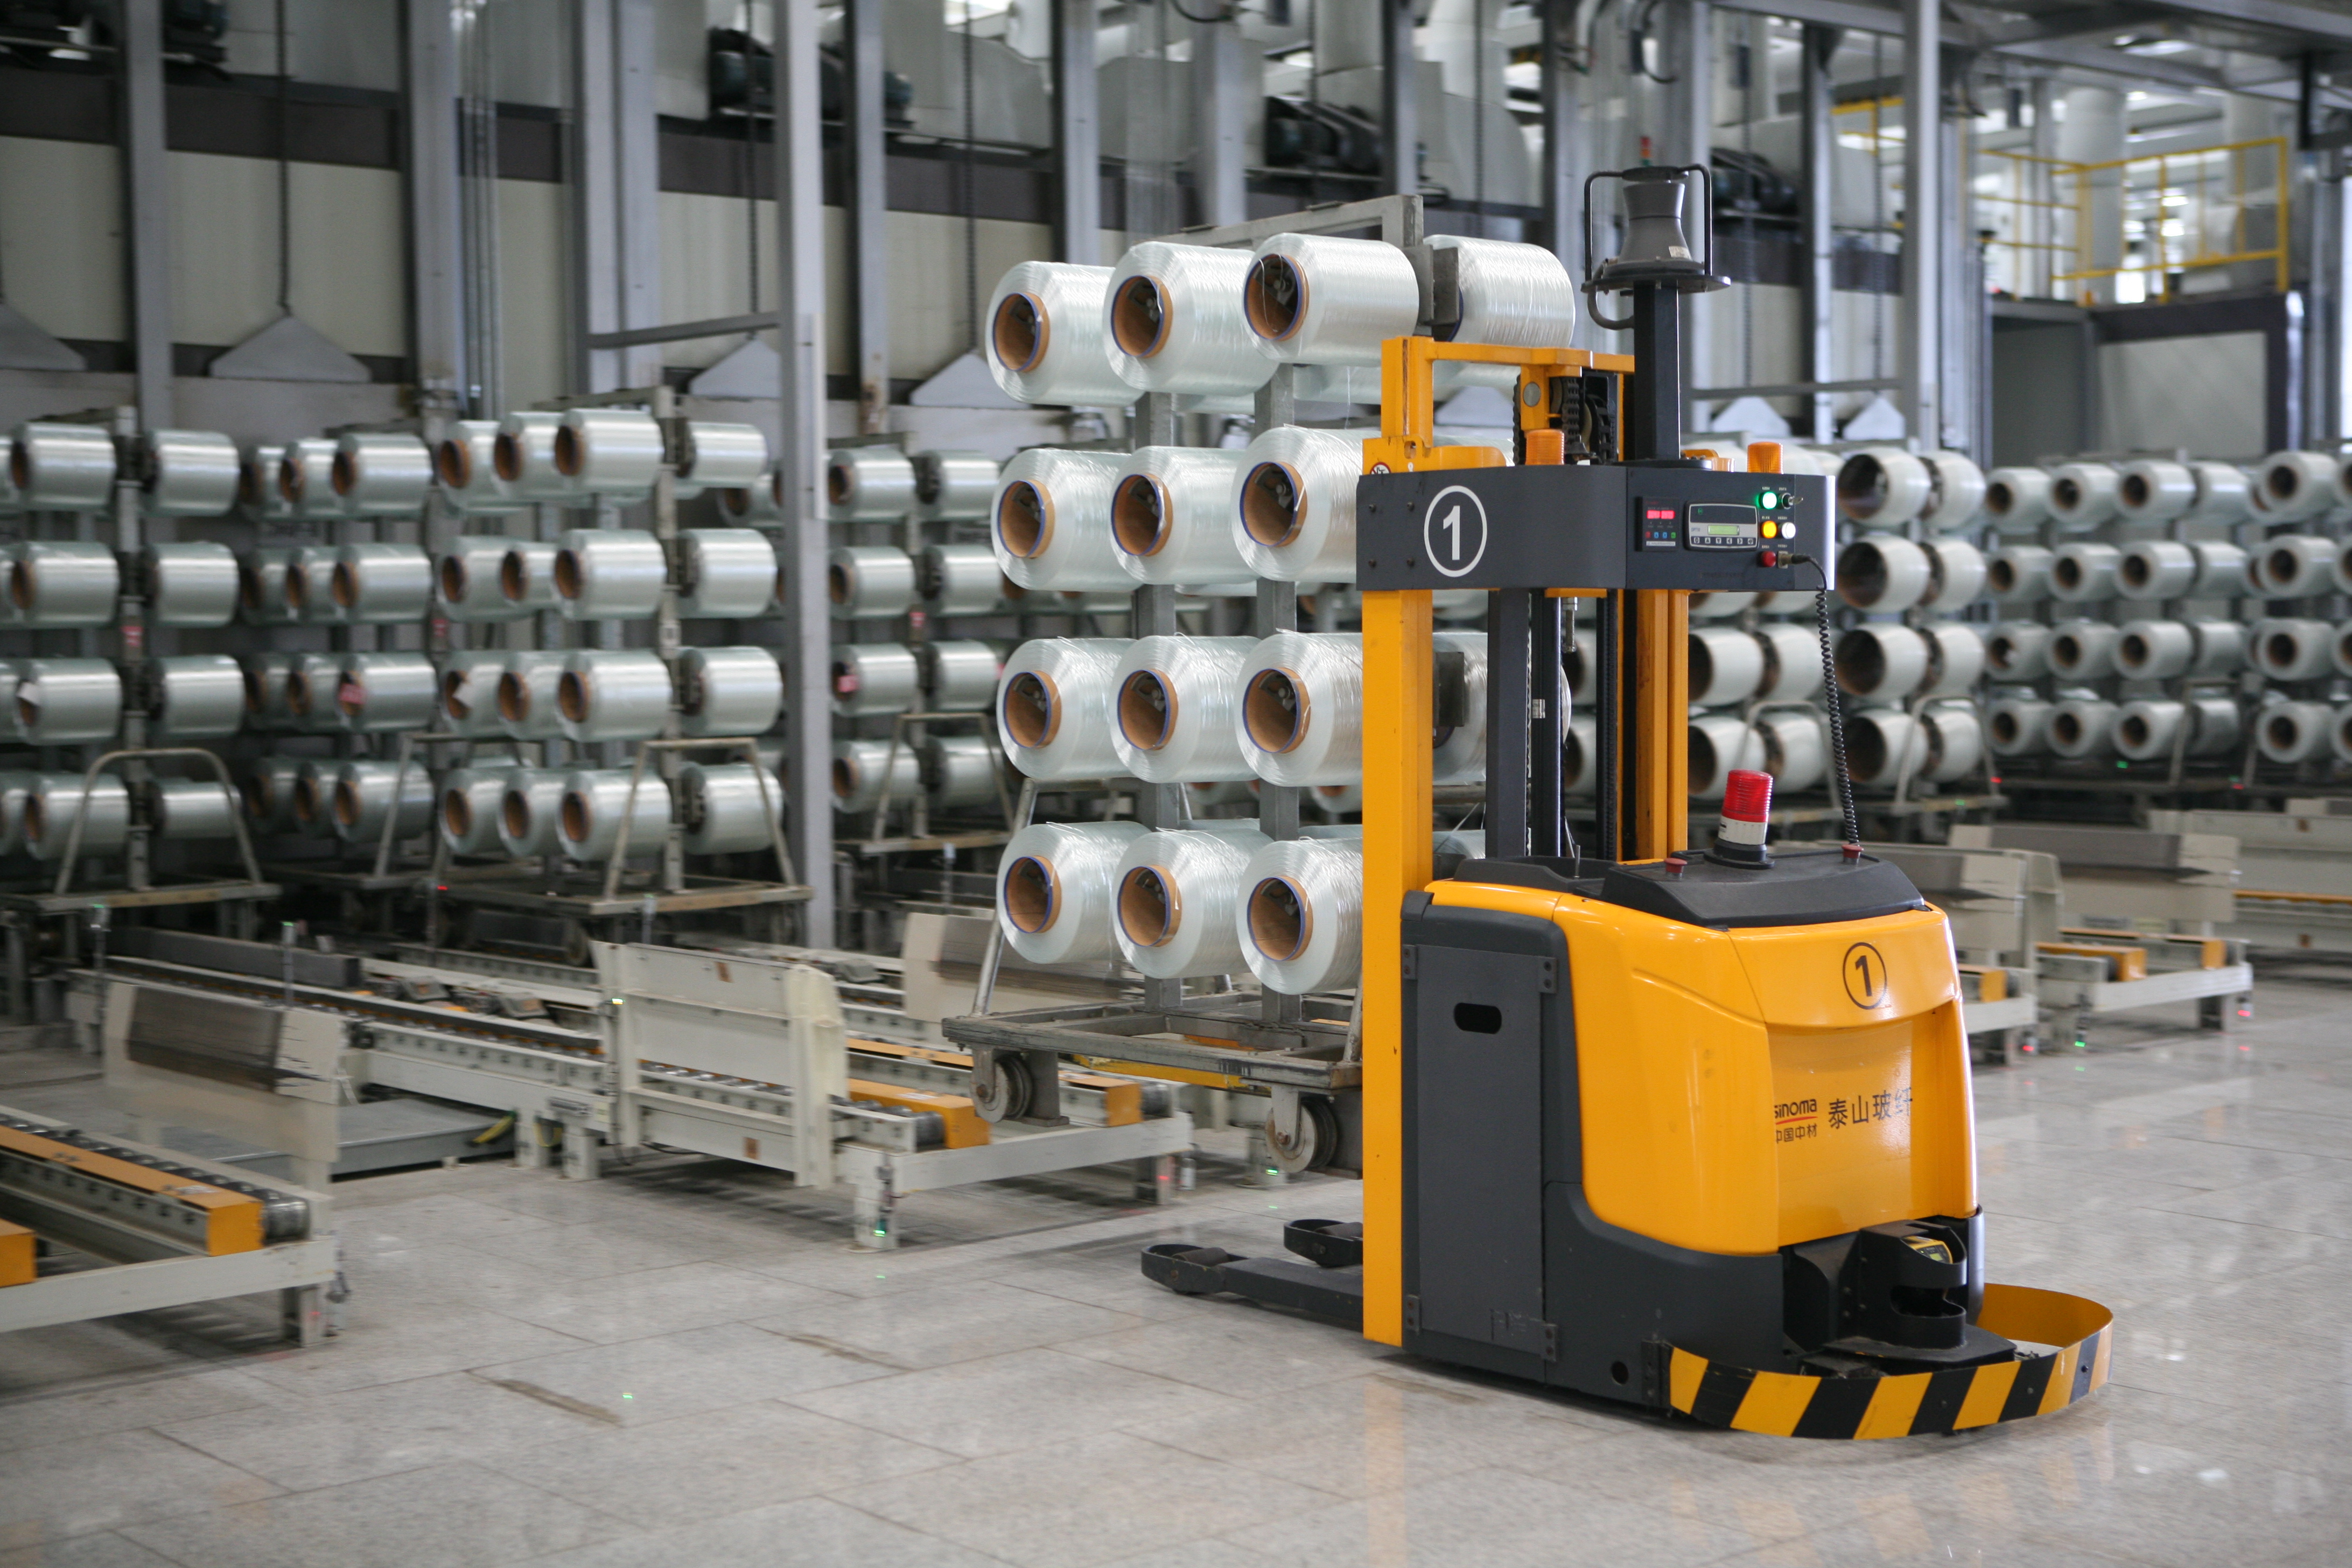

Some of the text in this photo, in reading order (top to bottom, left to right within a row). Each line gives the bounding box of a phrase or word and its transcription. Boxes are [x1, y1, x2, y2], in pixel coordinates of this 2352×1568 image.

[1443, 505, 1460, 560] 1
[1855, 955, 1872, 997] 1
[1828, 1087, 1913, 1130] 泰山玻纤
